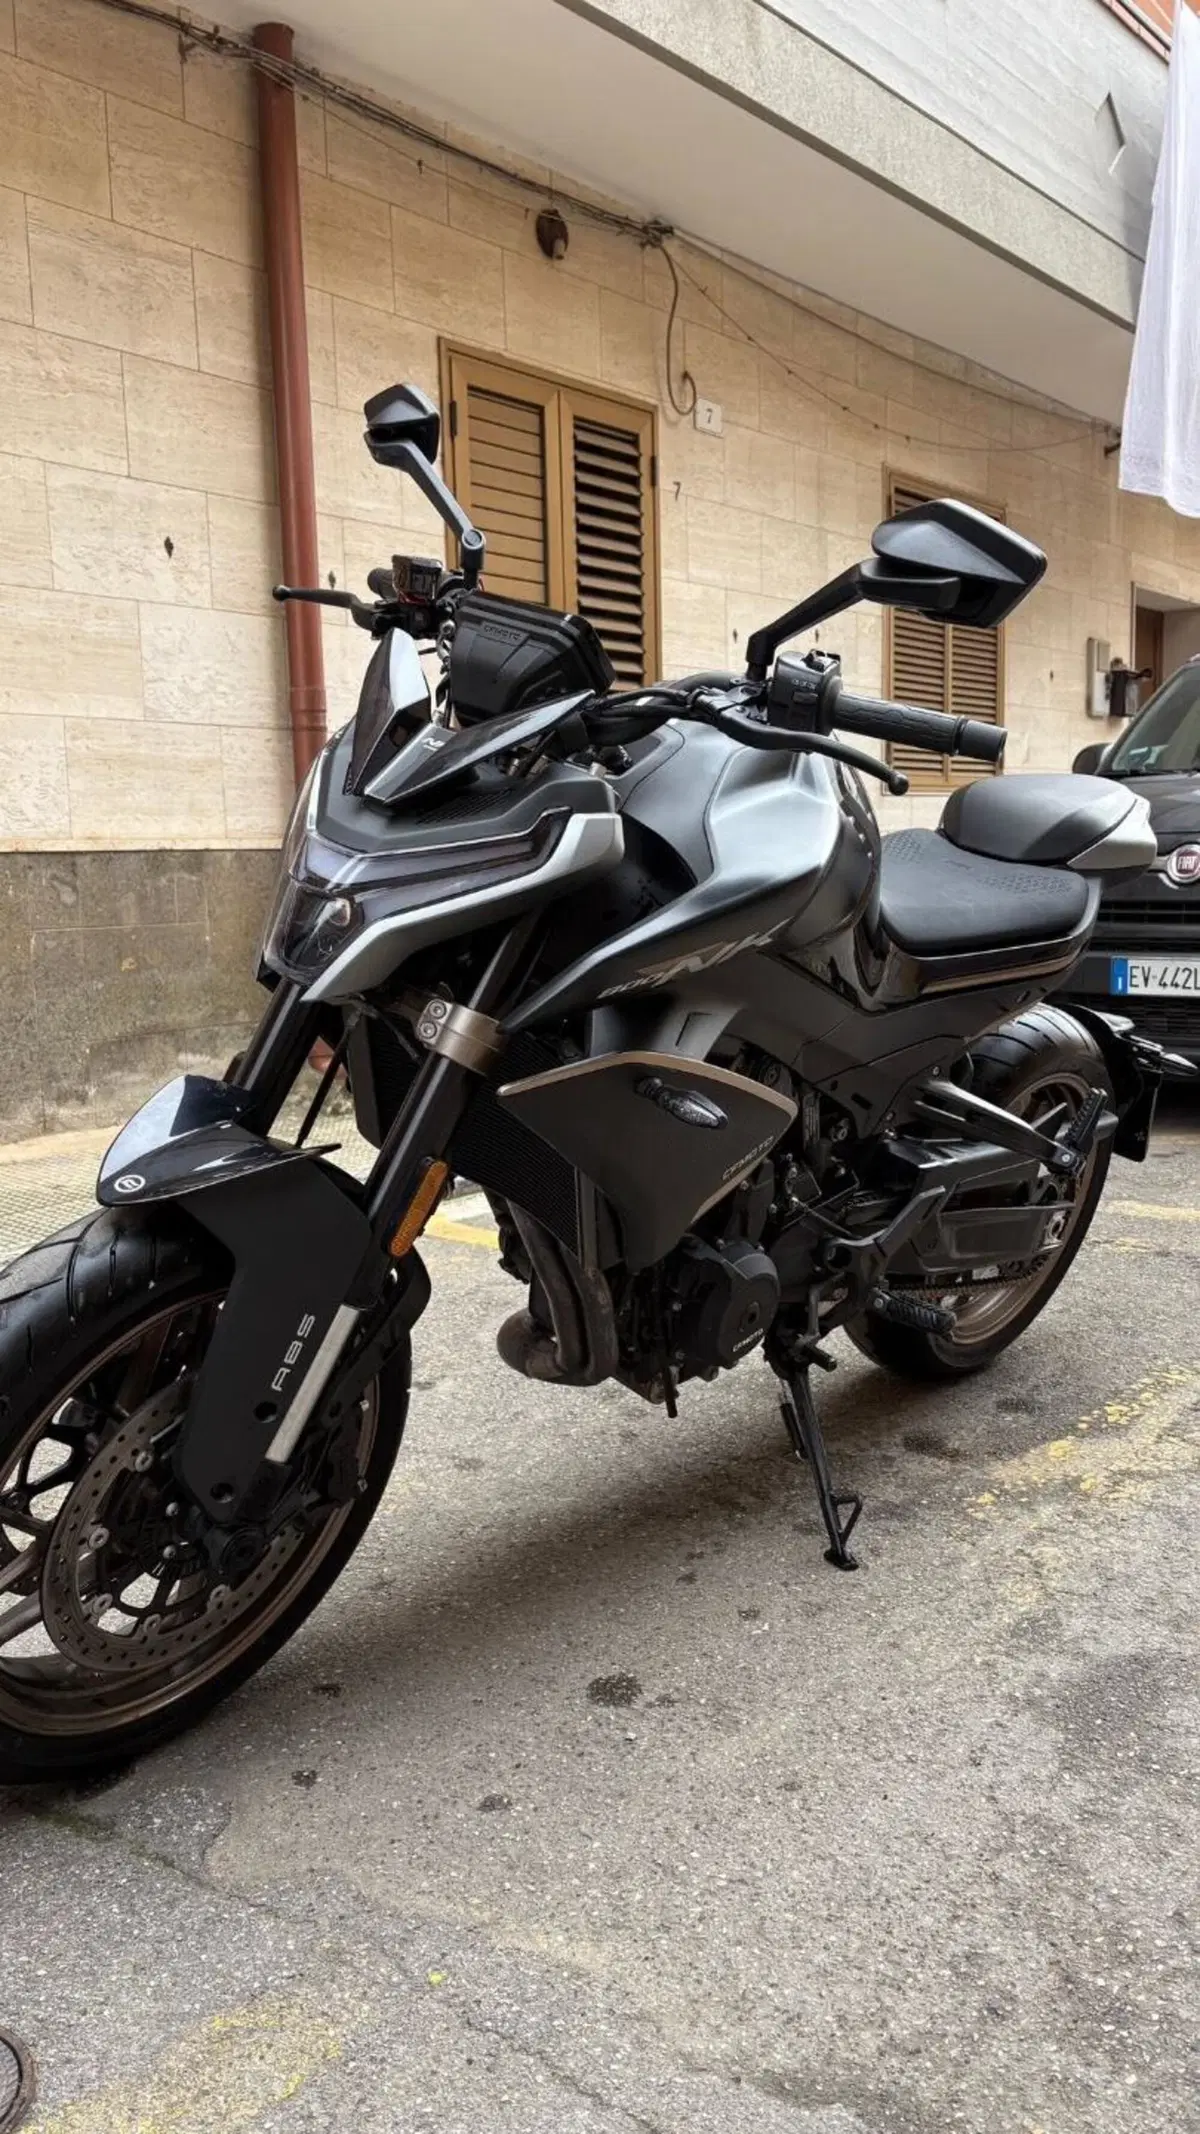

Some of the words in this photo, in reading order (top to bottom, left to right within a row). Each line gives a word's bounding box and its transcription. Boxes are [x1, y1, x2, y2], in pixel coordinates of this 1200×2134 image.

[706, 408, 713, 424] 7
[673, 481, 681, 501] 7
[1177, 856, 1198, 870] FIAT
[271, 1313, 316, 1391] ABS
